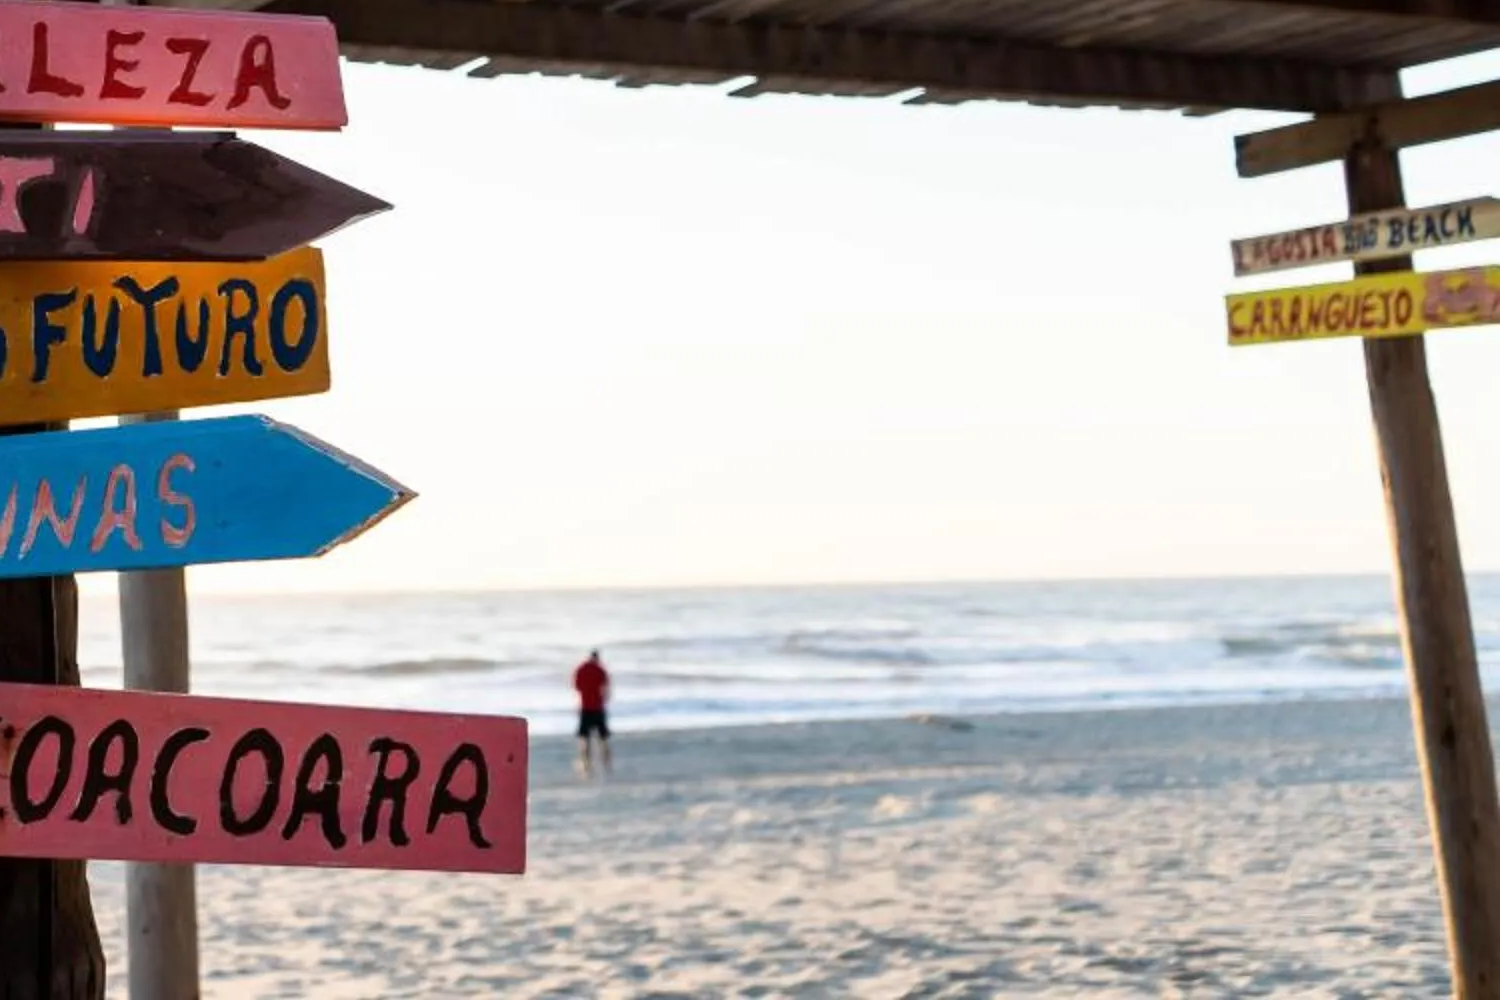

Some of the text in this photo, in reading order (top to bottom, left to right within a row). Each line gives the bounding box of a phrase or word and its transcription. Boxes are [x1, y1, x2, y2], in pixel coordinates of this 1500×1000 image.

[1387, 205, 1475, 249] BEACH
[30, 276, 323, 384] FUTURO
[1229, 286, 1413, 338] CARANGUEJO
